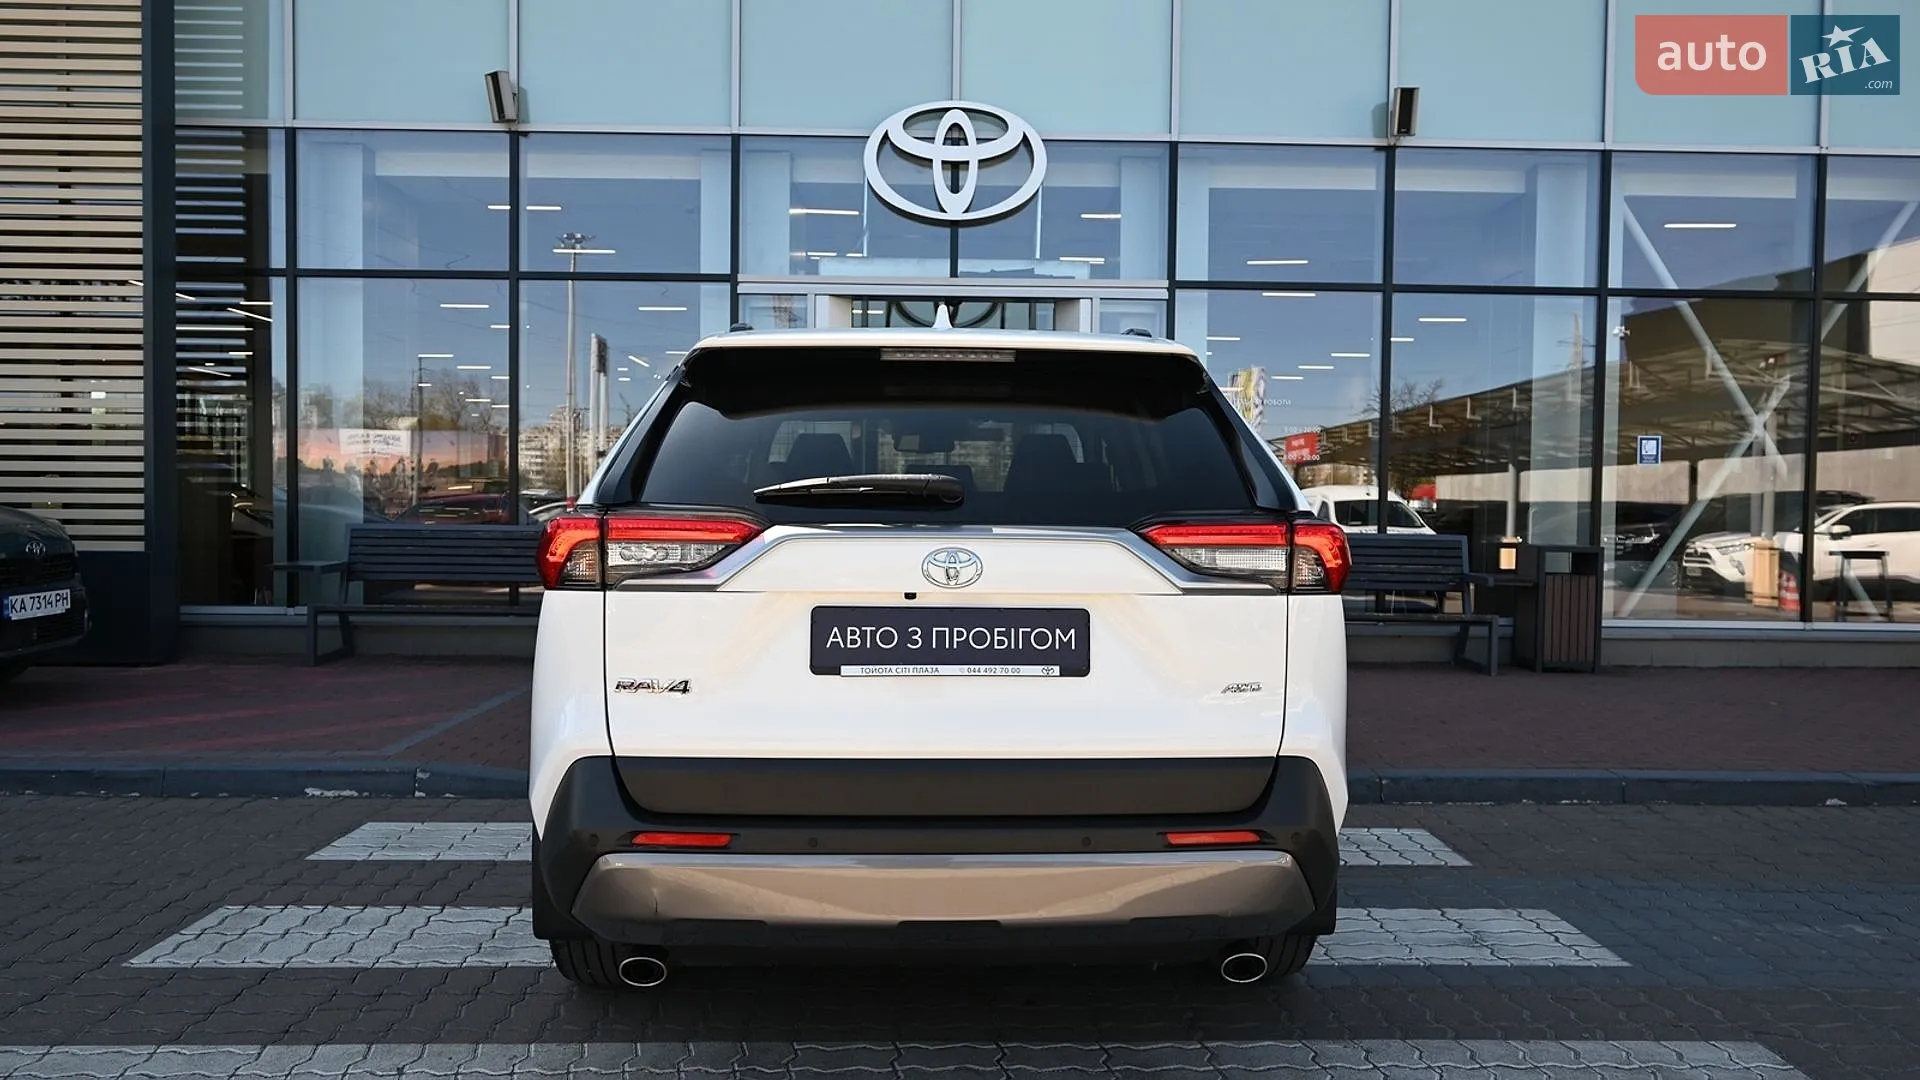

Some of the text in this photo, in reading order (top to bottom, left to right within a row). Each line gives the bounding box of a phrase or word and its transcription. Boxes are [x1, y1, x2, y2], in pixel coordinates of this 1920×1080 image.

[10, 598, 27, 613] KA
[29, 594, 53, 611] 7314
[826, 626, 898, 649] АВТО
[932, 627, 1076, 650] ПРОБІГОМ
[912, 666, 940, 674] ПЛАЗА
[983, 666, 998, 675] 492
[615, 677, 691, 694] RAV4
